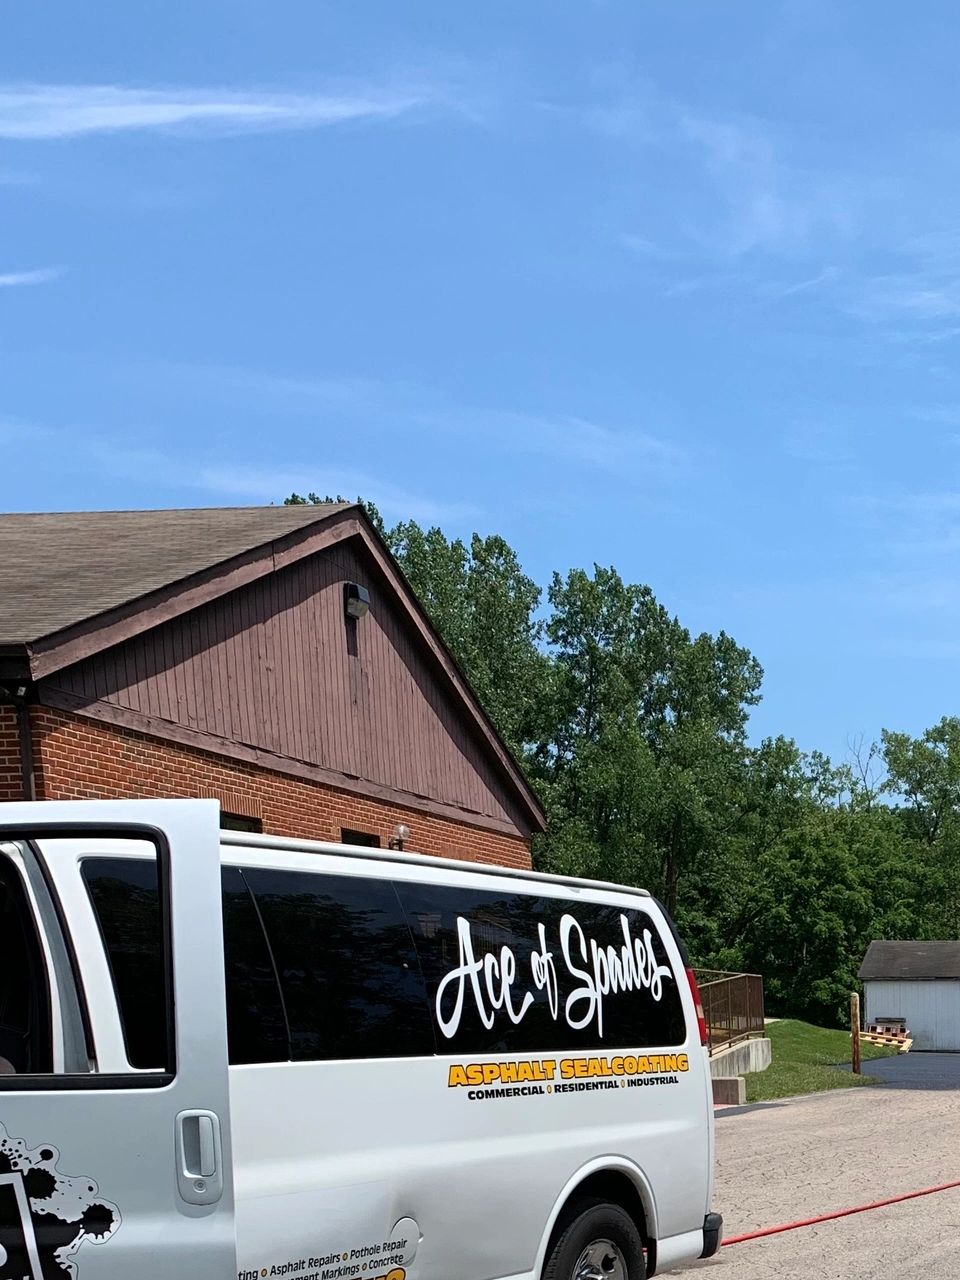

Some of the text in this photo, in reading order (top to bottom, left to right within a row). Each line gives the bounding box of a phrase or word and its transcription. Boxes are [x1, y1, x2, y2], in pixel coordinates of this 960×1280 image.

[436, 913, 673, 1039] Ace of Spades
[448, 1054, 689, 1087] ASPHALT SEALCOATING
[468, 1076, 679, 1100] COMMERCIAL RESIDENTIAL INDUSTRIAL
[270, 1259, 306, 1276] Asphalt
[308, 1253, 341, 1269] Repairs
[350, 1244, 381, 1260] Pothole
[382, 1238, 408, 1252] Repair
[321, 1263, 360, 1280] Markings
[368, 1254, 404, 1270] Concrete
